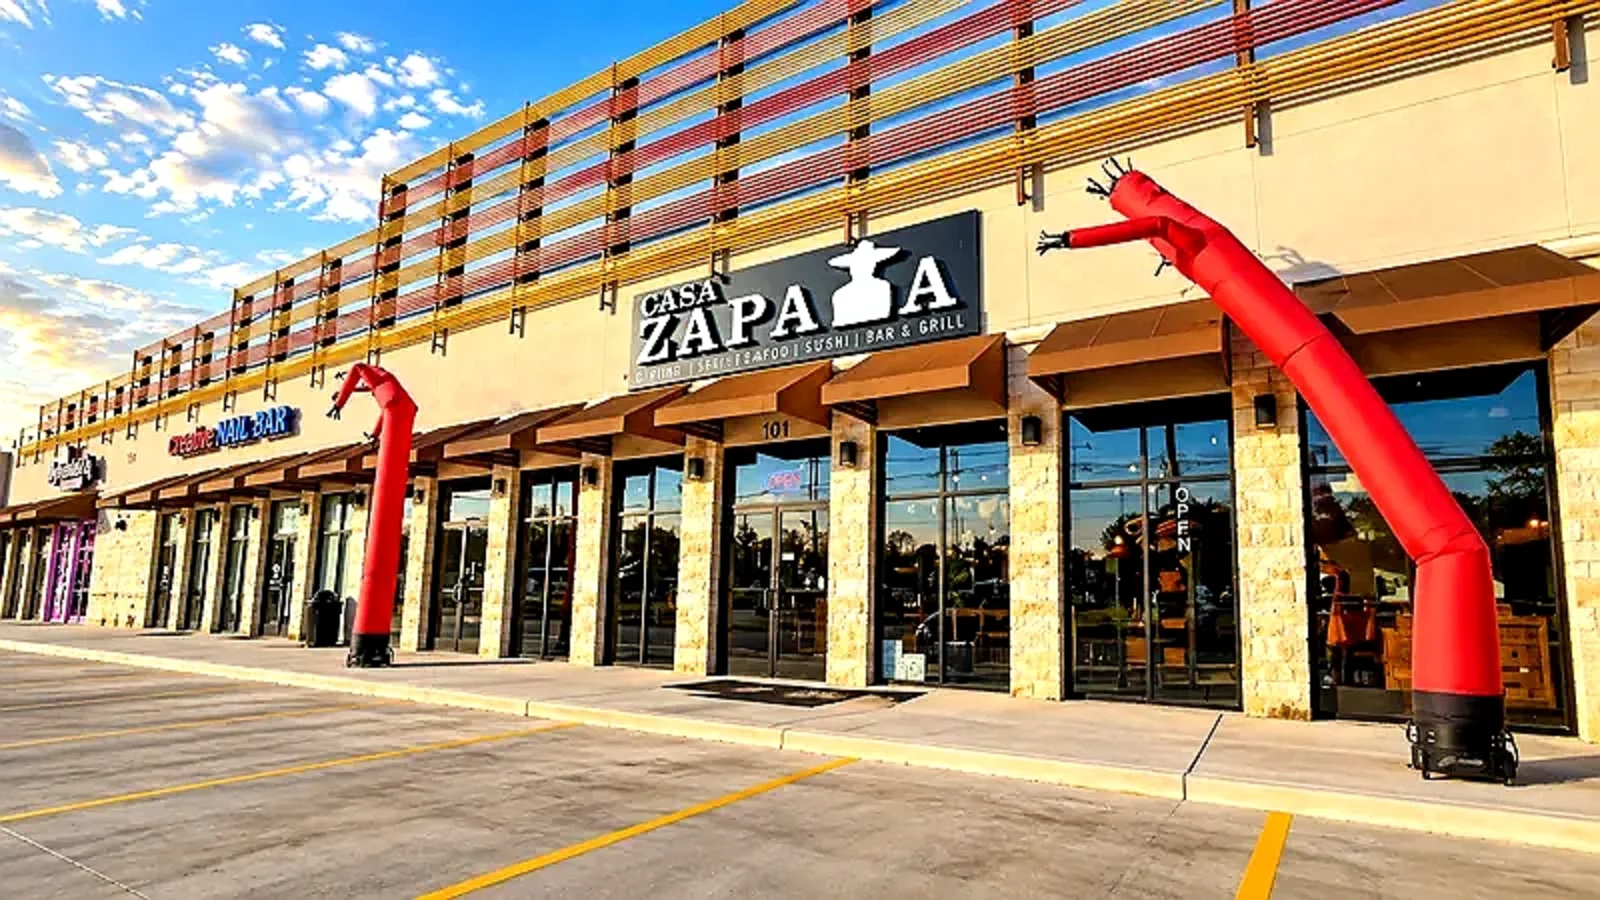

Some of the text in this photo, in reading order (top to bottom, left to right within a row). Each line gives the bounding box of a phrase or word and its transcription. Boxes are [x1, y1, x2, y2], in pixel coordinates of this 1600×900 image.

[640, 279, 717, 317] CASA
[805, 335, 849, 353] SUSHI
[866, 329, 895, 344] BAR
[901, 324, 911, 338] &
[919, 314, 965, 335] GRILL
[215, 415, 250, 447] NAIL
[252, 406, 290, 438] BAR
[762, 419, 789, 440] 101
[1175, 487, 1191, 552] OPEN
